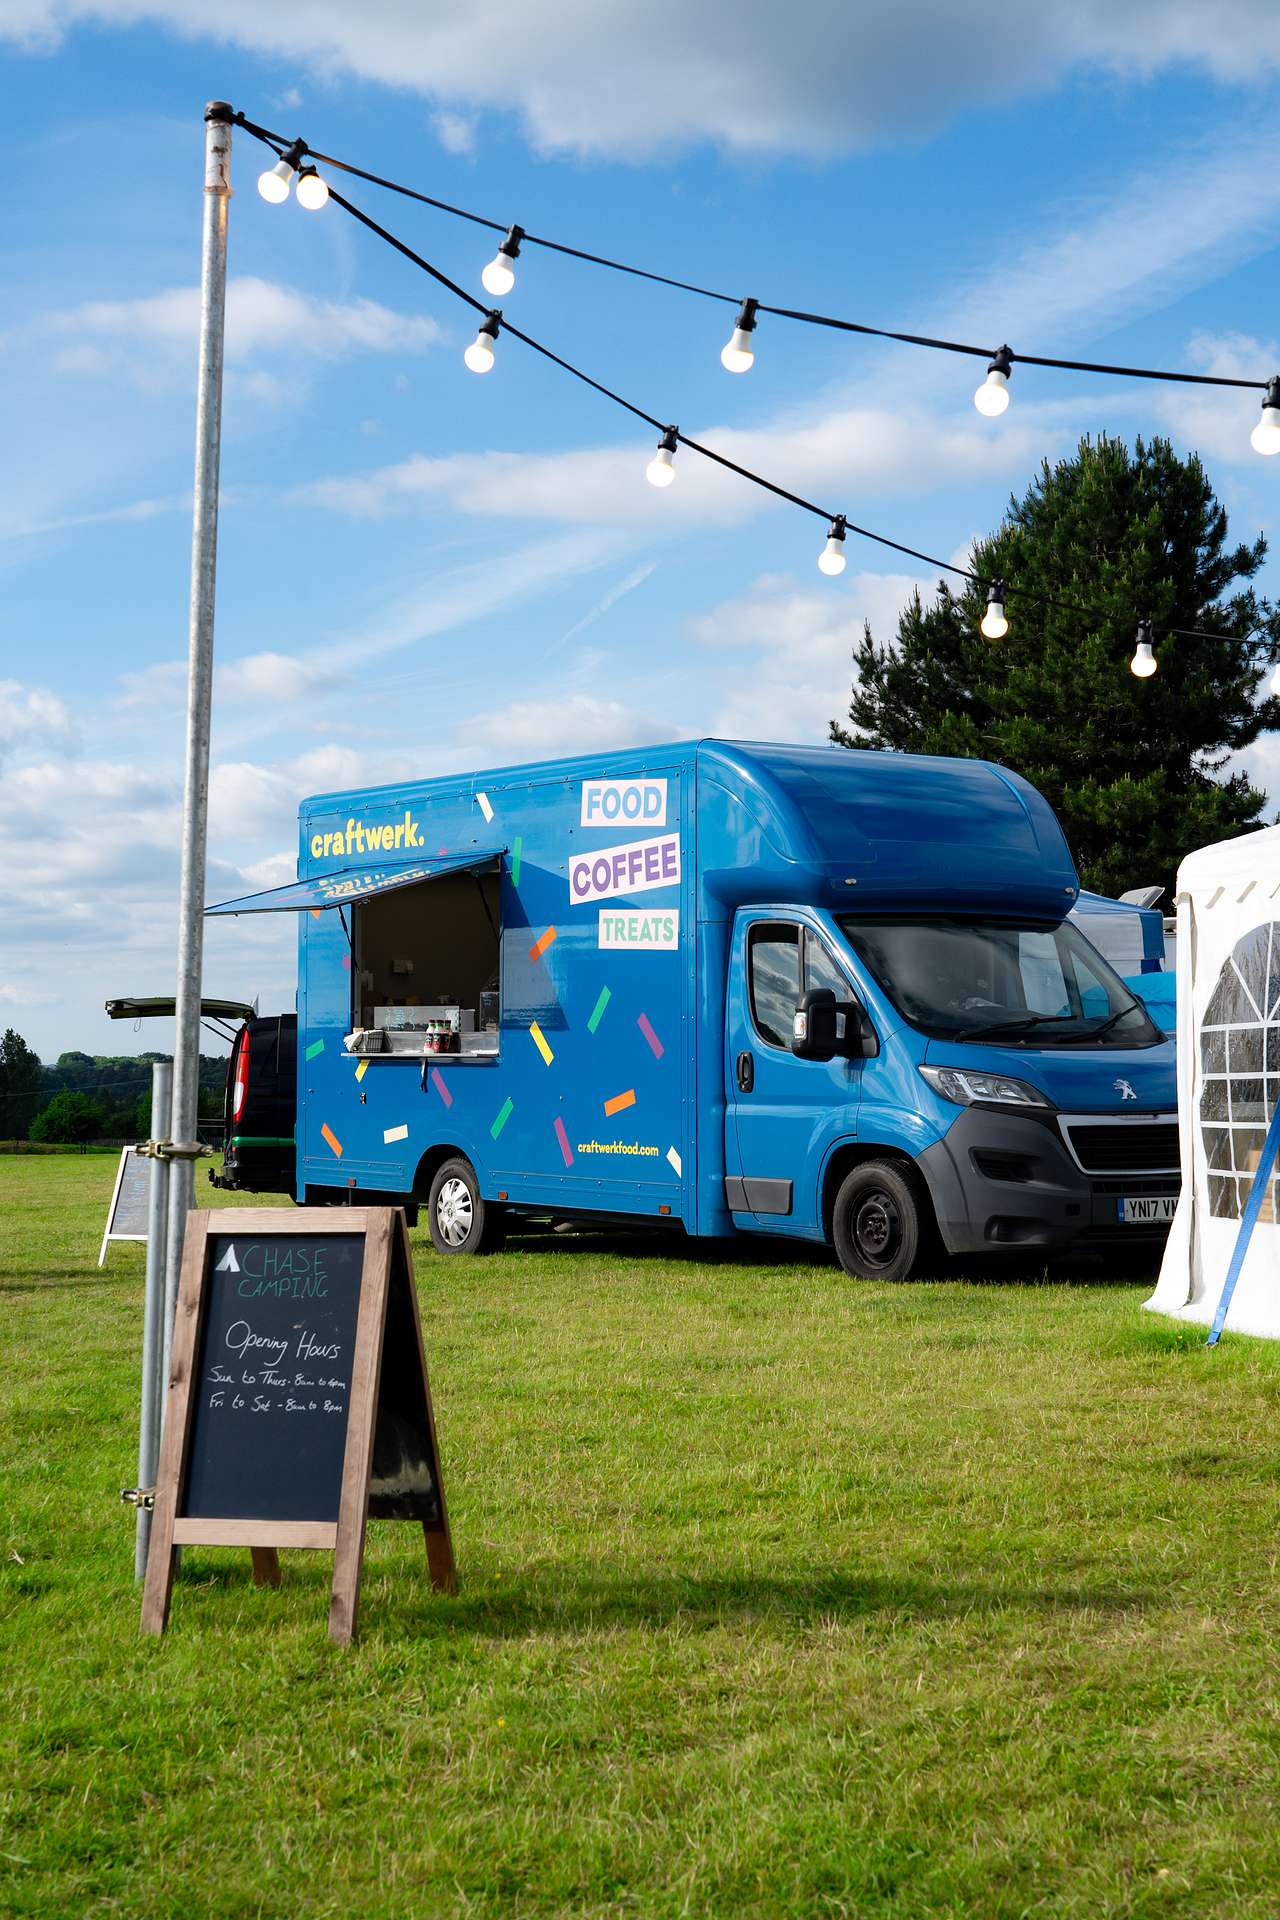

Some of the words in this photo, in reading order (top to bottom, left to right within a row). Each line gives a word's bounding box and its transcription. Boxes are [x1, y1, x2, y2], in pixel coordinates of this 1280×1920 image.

[587, 786, 662, 819] FOOD
[311, 811, 424, 858] craftwerk.
[573, 842, 677, 897] COFFEE
[603, 917, 674, 942] TREATS
[577, 1140, 659, 1156] craftwerkfood.com
[1130, 1200, 1158, 1218] YN17
[242, 1244, 327, 1278] CHASE
[238, 1275, 329, 1298] CAMPING
[225, 1320, 288, 1367] Opening
[296, 1330, 341, 1360] Hours
[207, 1365, 235, 1384] Sun
[241, 1369, 256, 1384] to
[318, 1377, 327, 1386] to
[209, 1391, 225, 1408] Fri
[231, 1393, 245, 1409] to
[251, 1395, 271, 1412] Sat
[308, 1400, 317, 1410] to
[323, 1399, 343, 1413] 8pm
